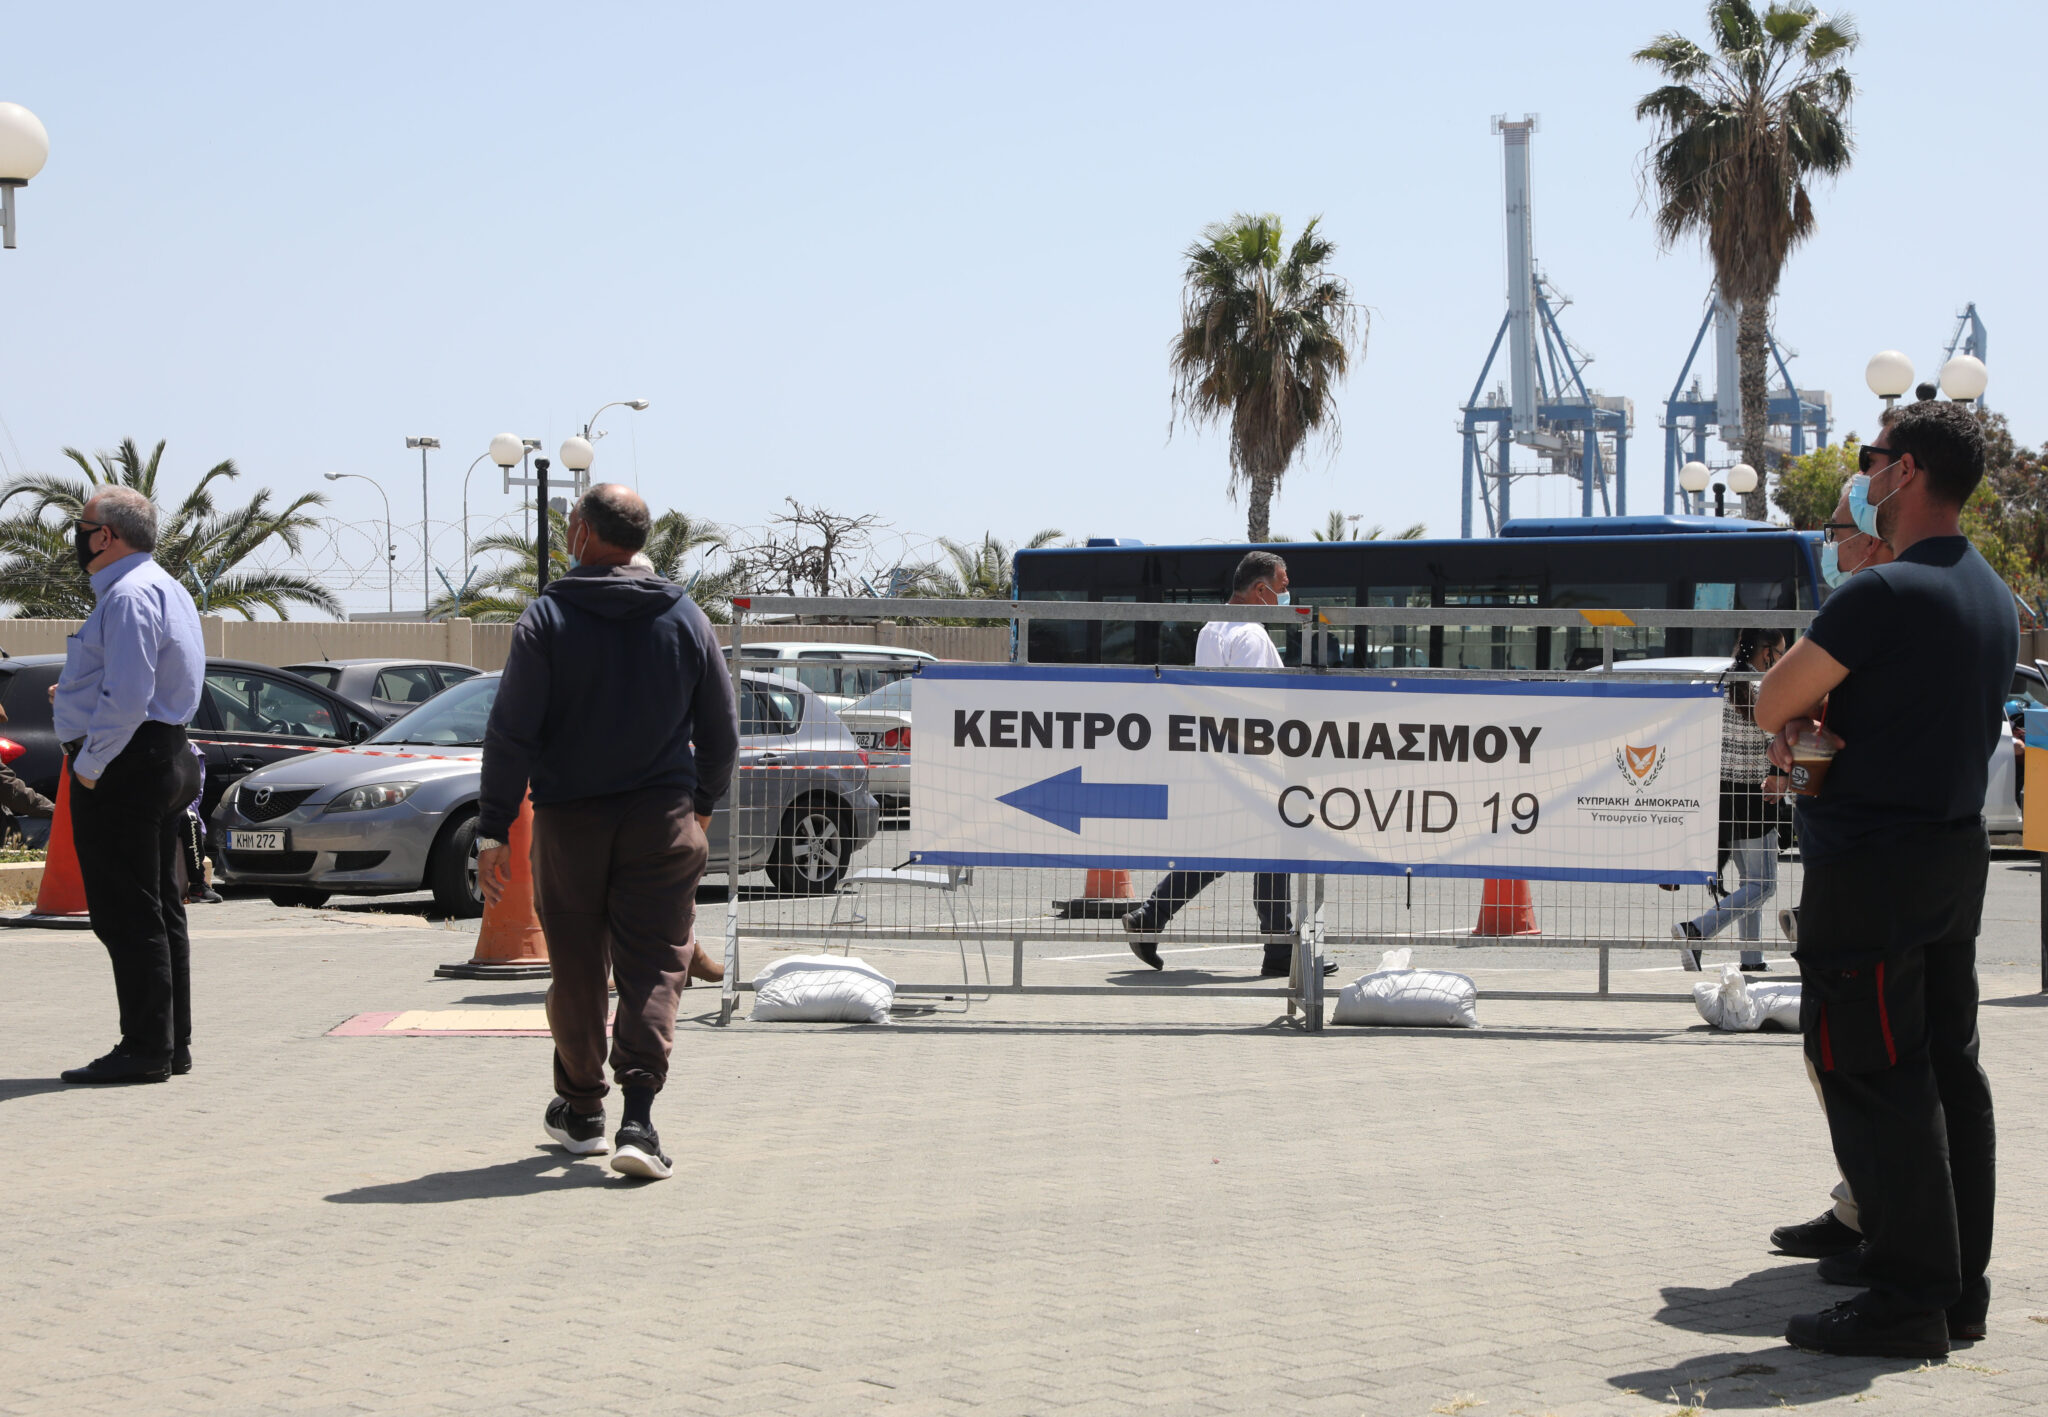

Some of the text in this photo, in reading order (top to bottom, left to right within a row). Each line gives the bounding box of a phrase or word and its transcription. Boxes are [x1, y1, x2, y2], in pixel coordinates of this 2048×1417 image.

[954, 709, 1543, 764] ΚΕΝΤΡΟ ΕΜΒΟΛΙΑΣΜΟΥ
[1277, 785, 1540, 835] COVID 19
[1577, 796, 1700, 808] ΚΥΠΡΙΑΚΗ ΔΗΜΟΚΡΑΤΙΑ
[1591, 812, 1684, 826] Υπουργείο Υγείας
[236, 833, 276, 849] KHM 272
